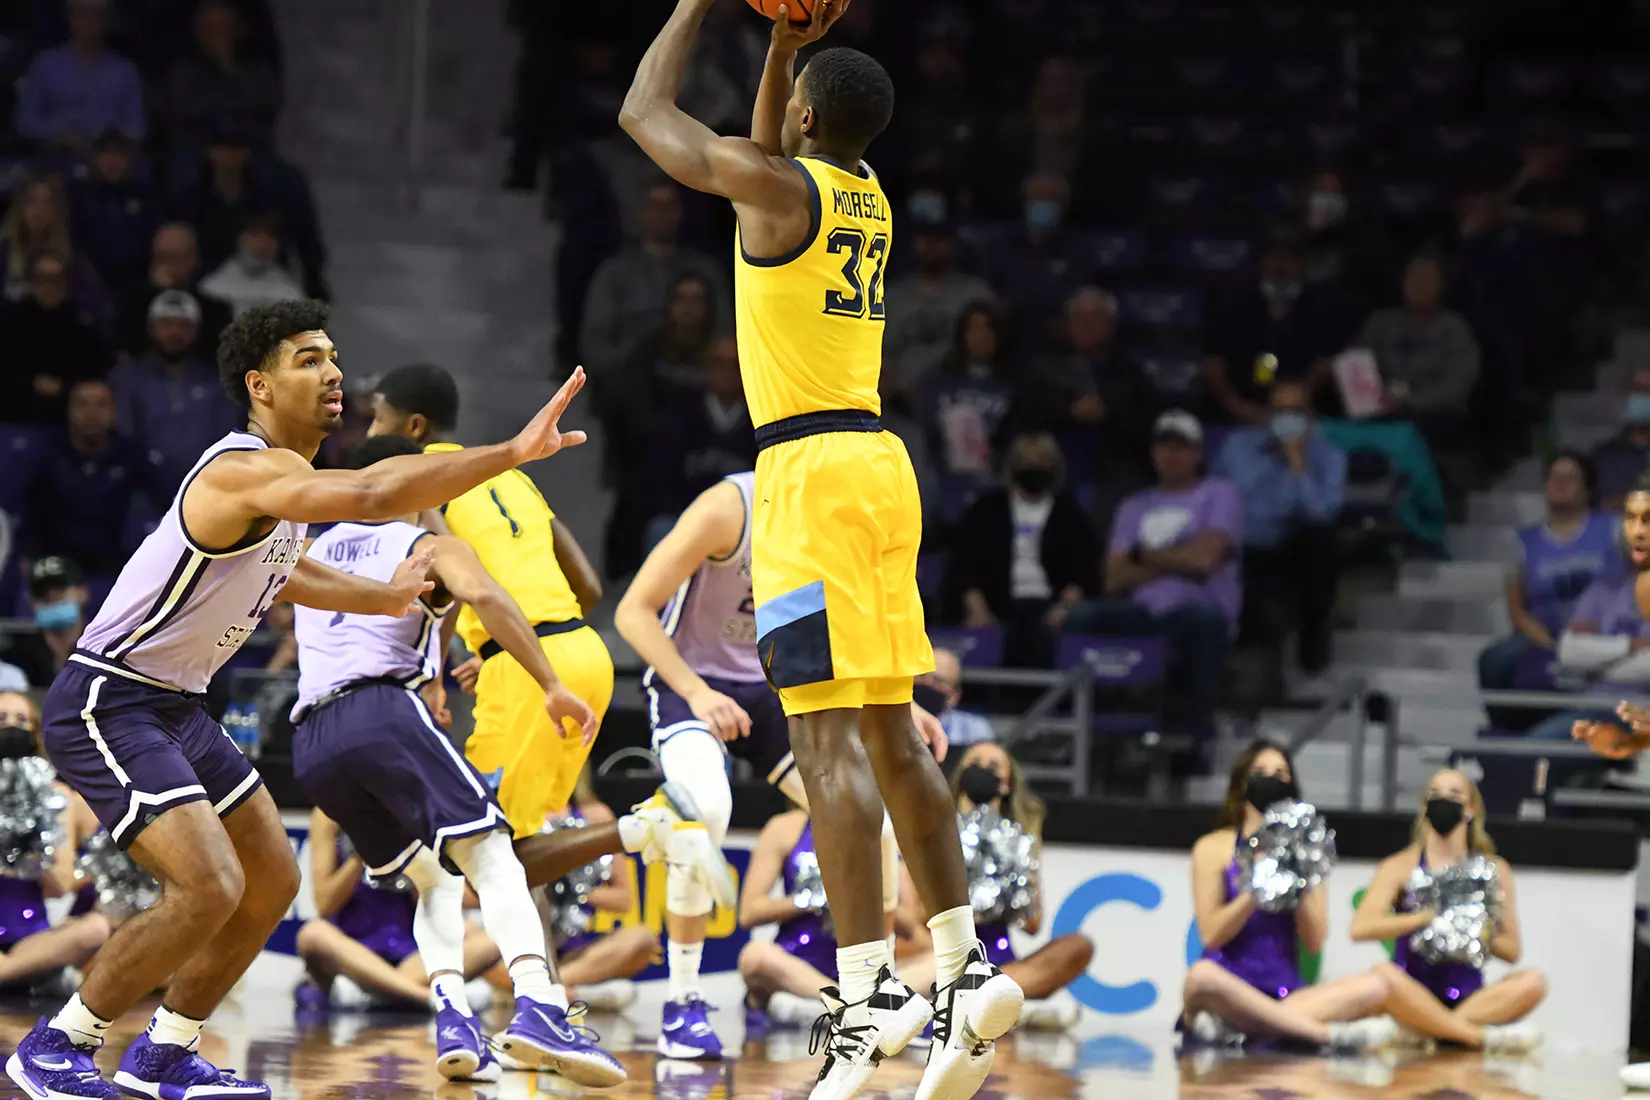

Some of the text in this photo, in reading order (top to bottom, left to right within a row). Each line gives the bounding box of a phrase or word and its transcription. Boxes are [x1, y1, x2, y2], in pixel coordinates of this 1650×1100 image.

[832, 187, 886, 221] MORSELL
[822, 227, 886, 320] 32
[324, 539, 381, 562] NOWELL
